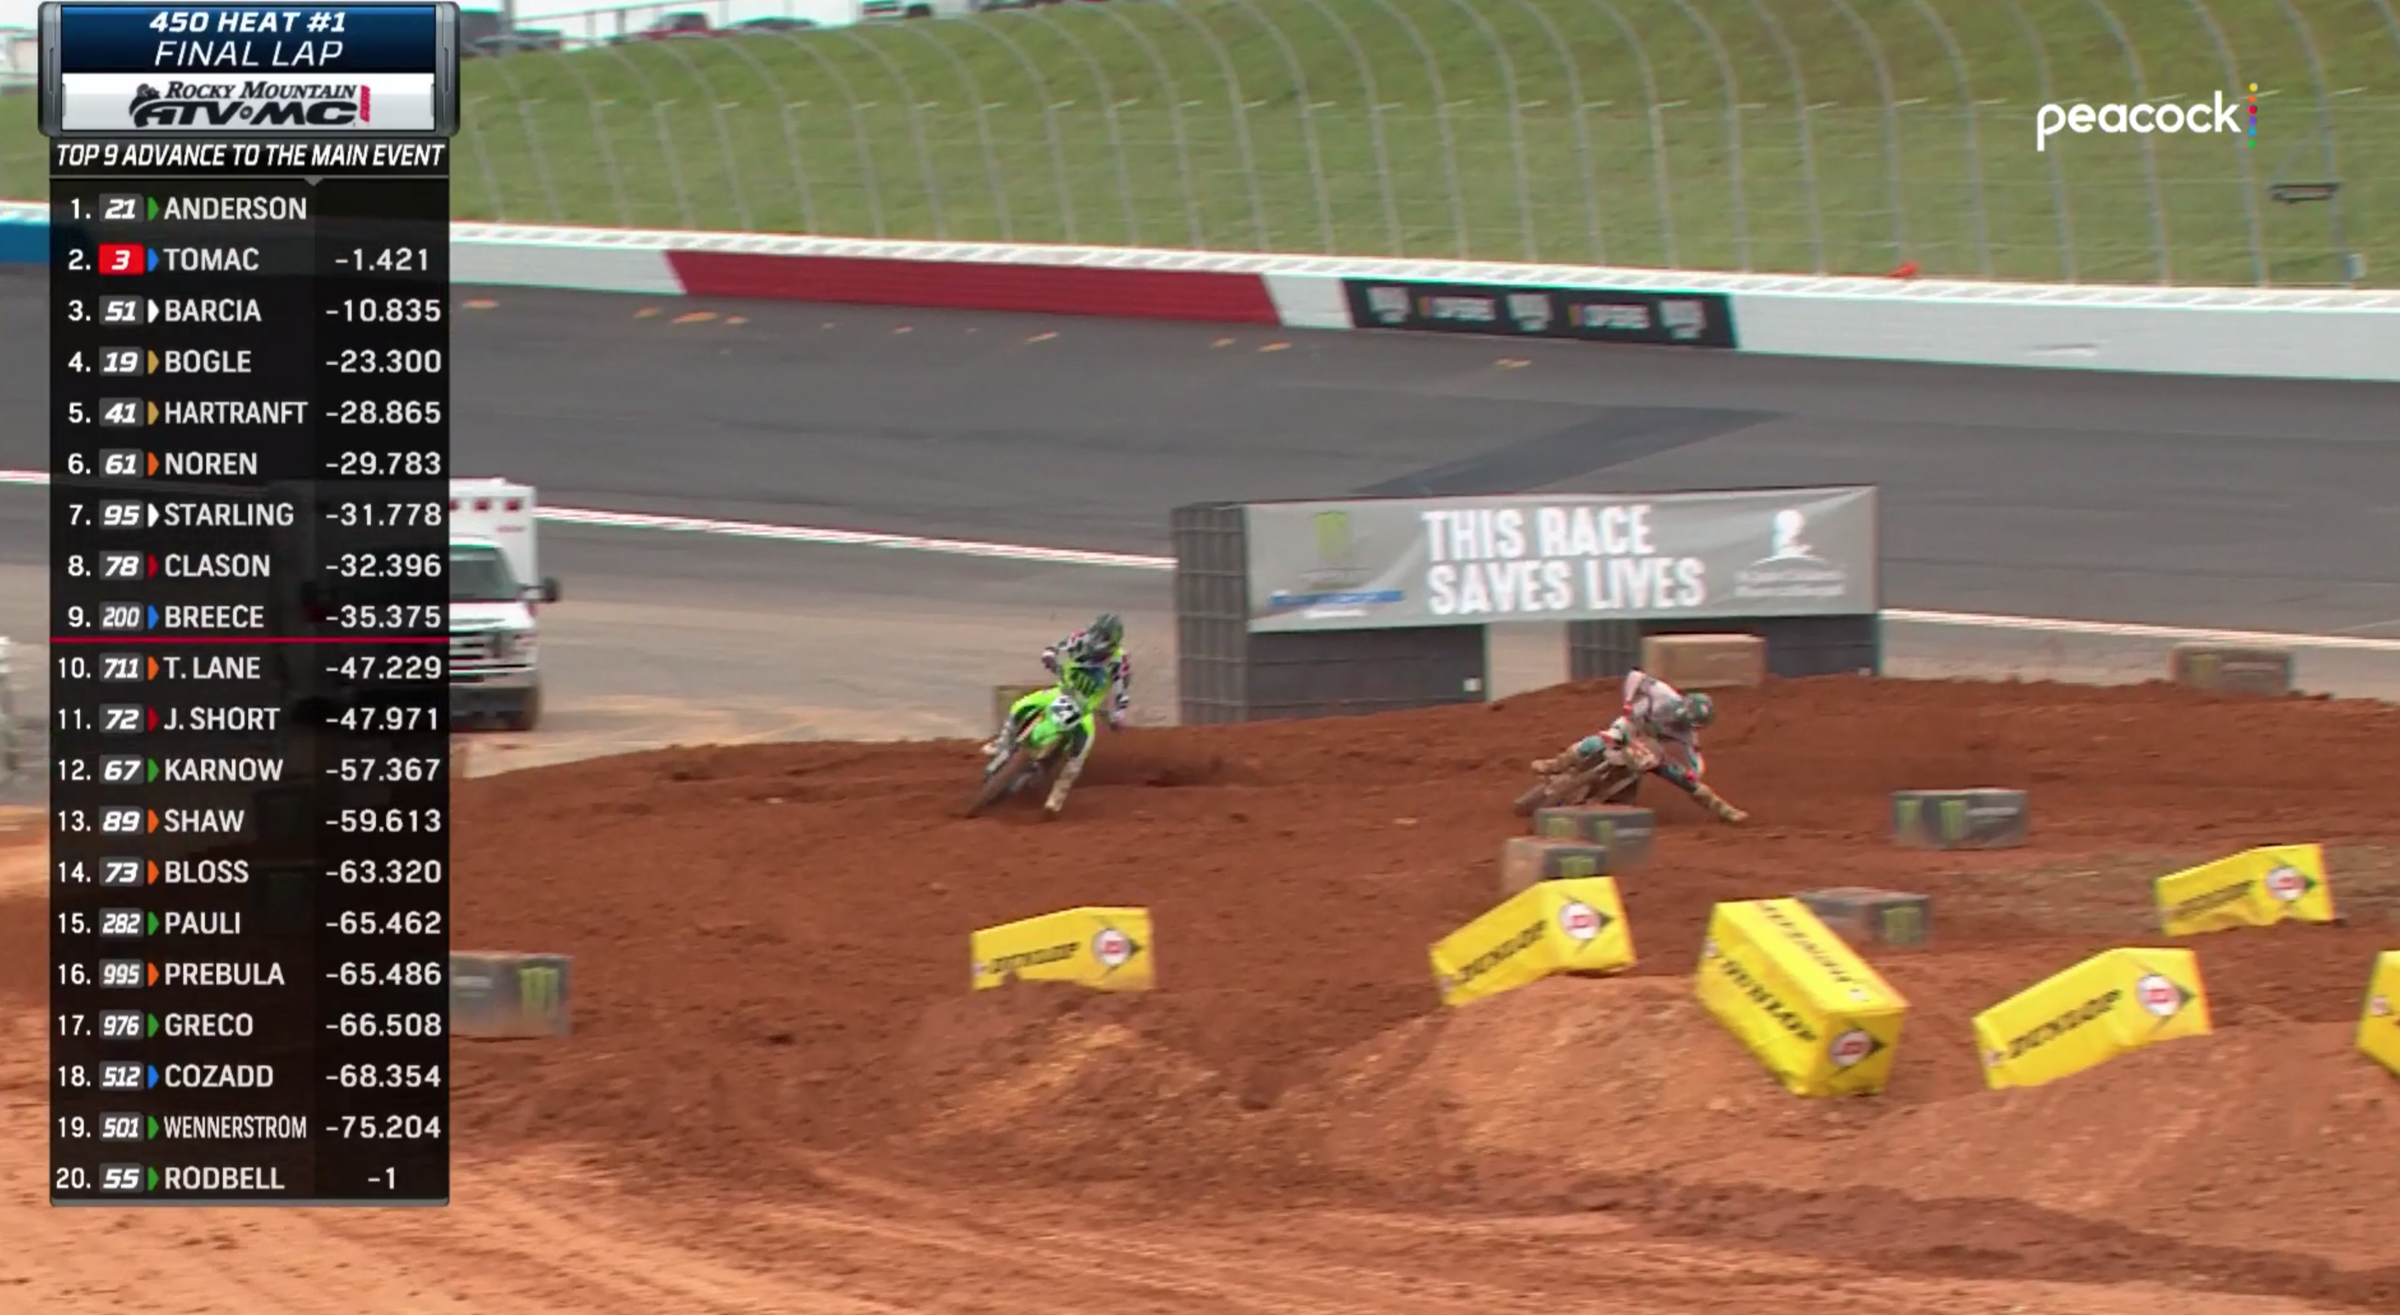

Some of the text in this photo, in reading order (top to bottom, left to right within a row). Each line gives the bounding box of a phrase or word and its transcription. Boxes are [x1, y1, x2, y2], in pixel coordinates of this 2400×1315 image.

[1421, 504, 1656, 561] THIS RACE
[1427, 557, 1707, 615] SAVES LIVES
